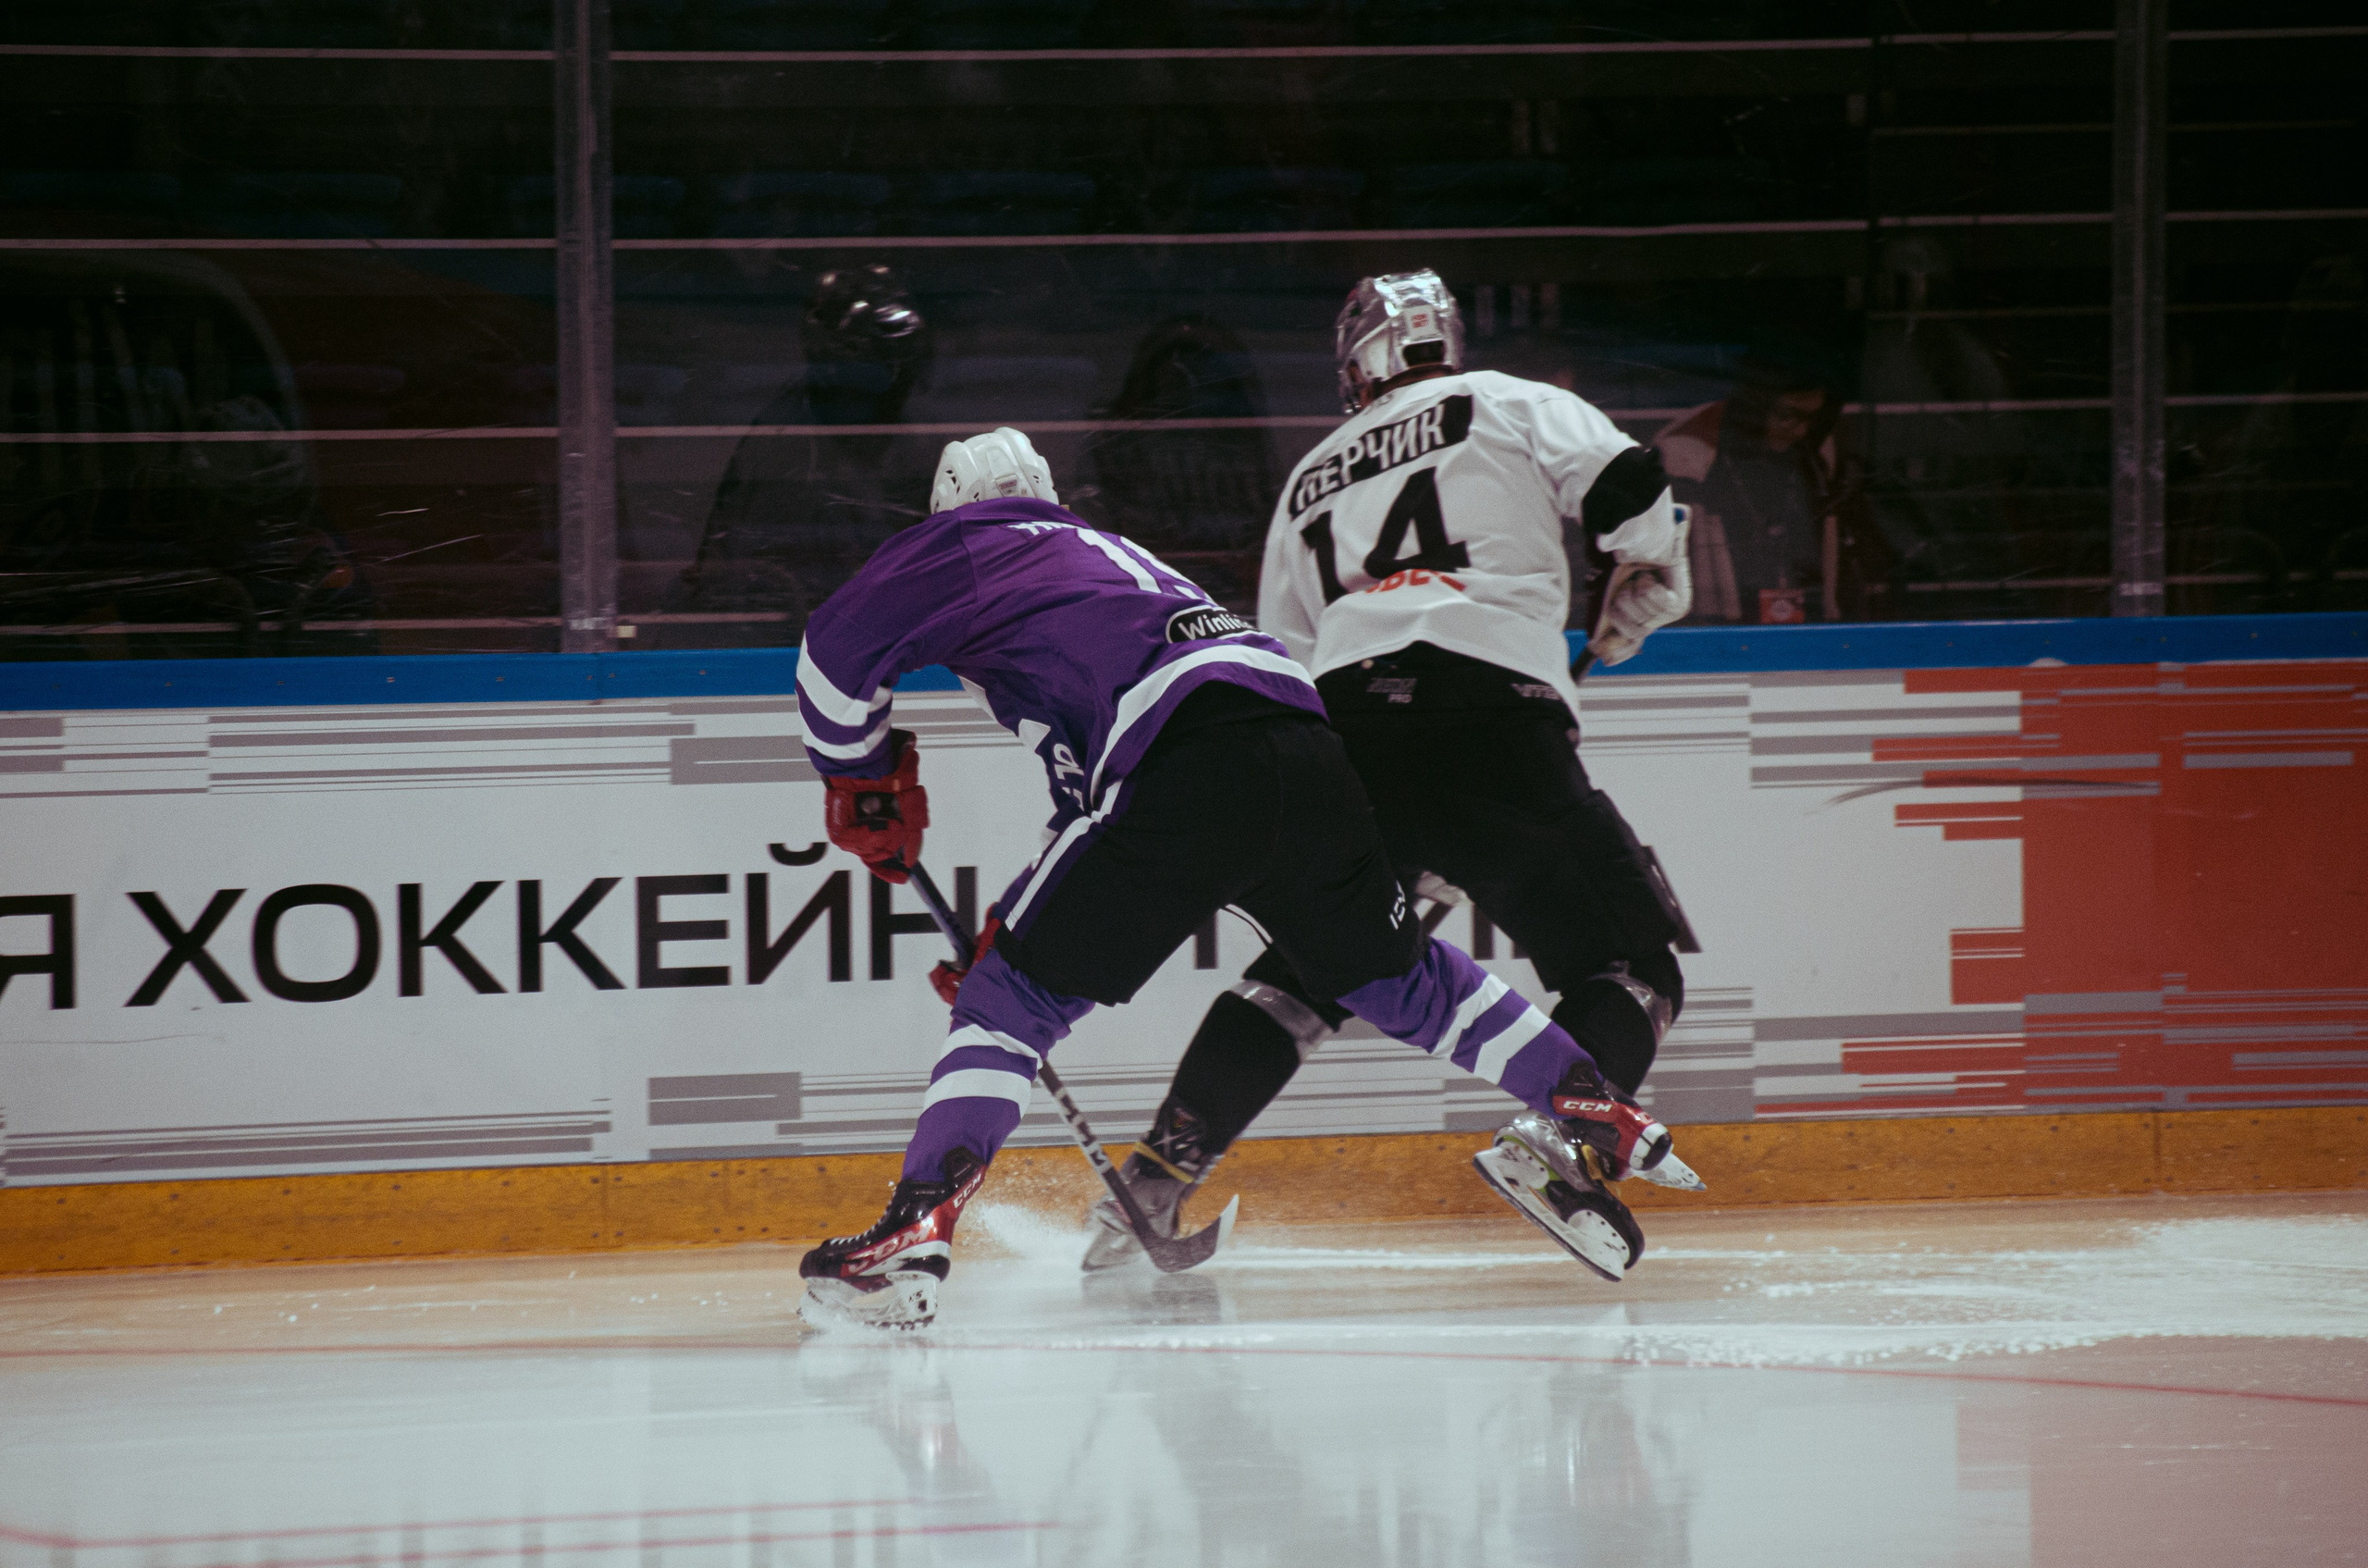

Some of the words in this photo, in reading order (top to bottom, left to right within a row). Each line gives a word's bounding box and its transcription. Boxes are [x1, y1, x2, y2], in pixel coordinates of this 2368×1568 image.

[1296, 402, 1446, 511] ПЕРЧИК
[1300, 465, 1471, 607] 14
[1178, 613, 1255, 641] Winli
[123, 842, 1219, 1008] ХОККЕЙН
[1563, 1100, 1613, 1113] CCM
[953, 1172, 982, 1209] CCM
